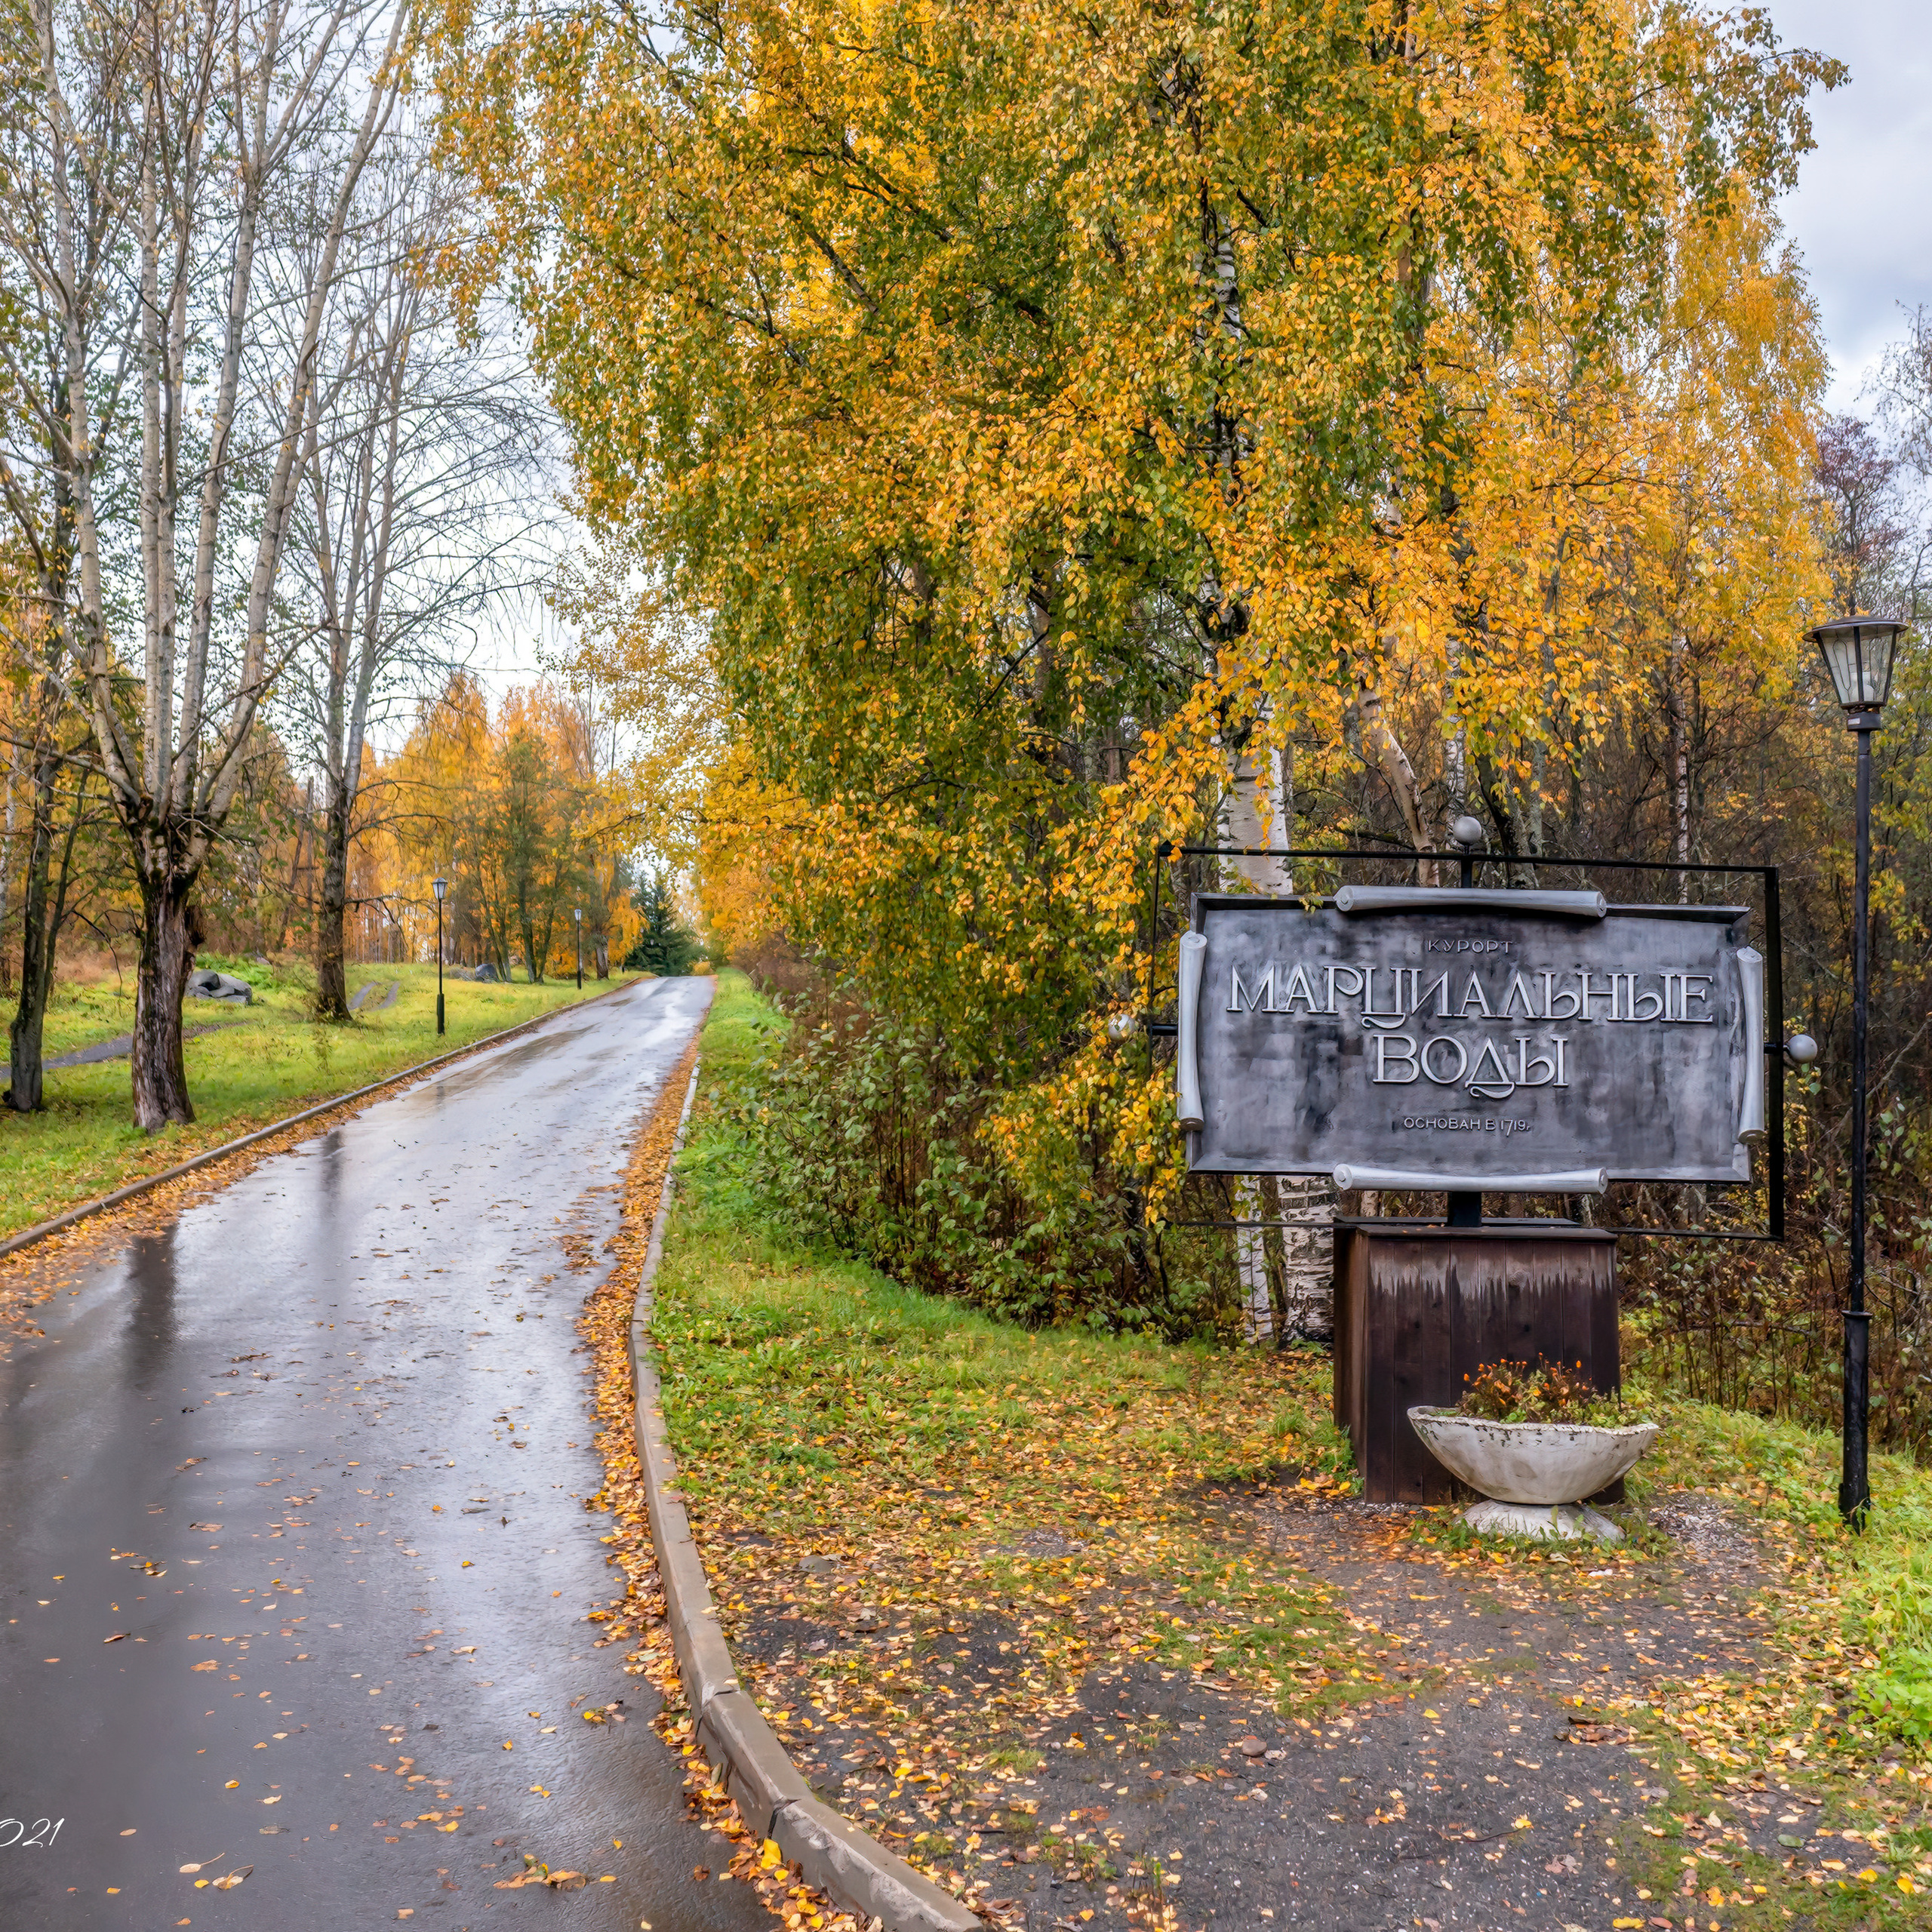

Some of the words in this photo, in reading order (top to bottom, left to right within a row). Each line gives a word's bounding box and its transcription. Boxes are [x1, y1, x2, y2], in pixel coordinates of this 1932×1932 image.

[1427, 939, 1513, 953] КУРОРТ
[1226, 964, 1714, 1029] МАРЦИАЛЬНЫЕ
[1373, 1034, 1569, 1099] ВОДЫ
[1404, 1117, 1481, 1131] ОСНОВАН
[1485, 1118, 1497, 1131] В
